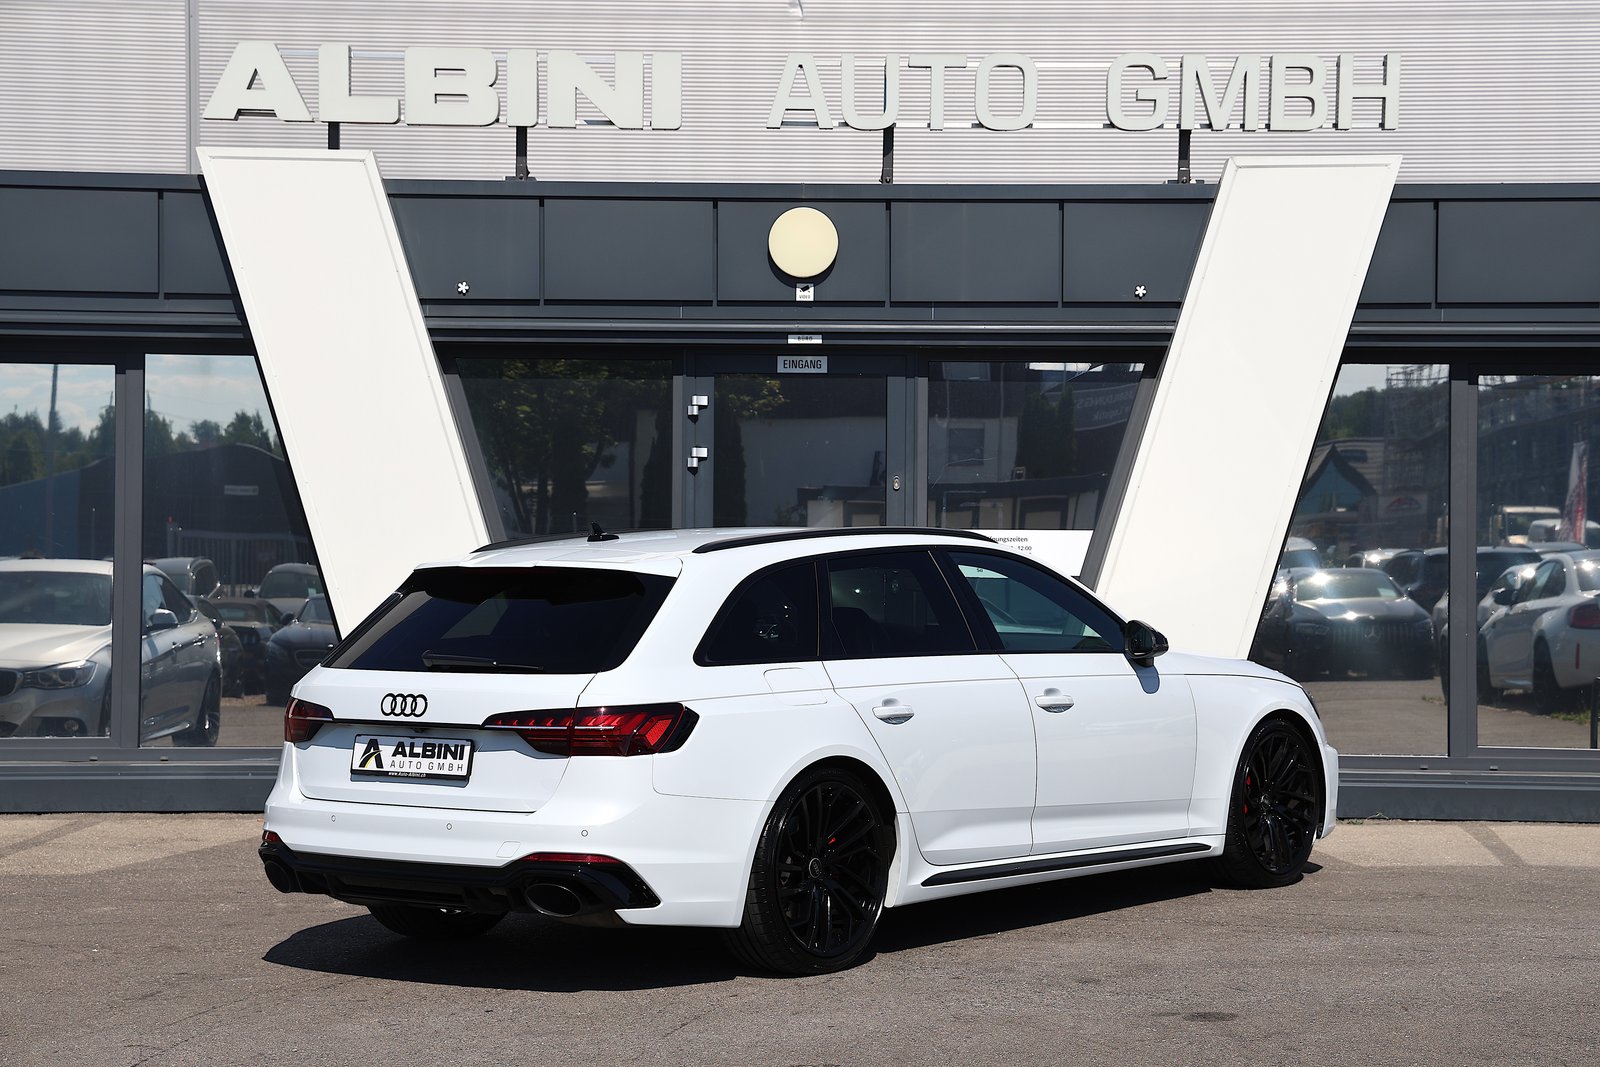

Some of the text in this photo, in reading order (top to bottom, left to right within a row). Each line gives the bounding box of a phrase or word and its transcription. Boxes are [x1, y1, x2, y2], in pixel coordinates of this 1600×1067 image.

[202, 41, 1401, 132] ALBINI AUTO GMBH
[783, 359, 822, 369] EINGANG
[391, 741, 466, 760] ALBINI
[390, 760, 464, 772] AUTO GMBH
